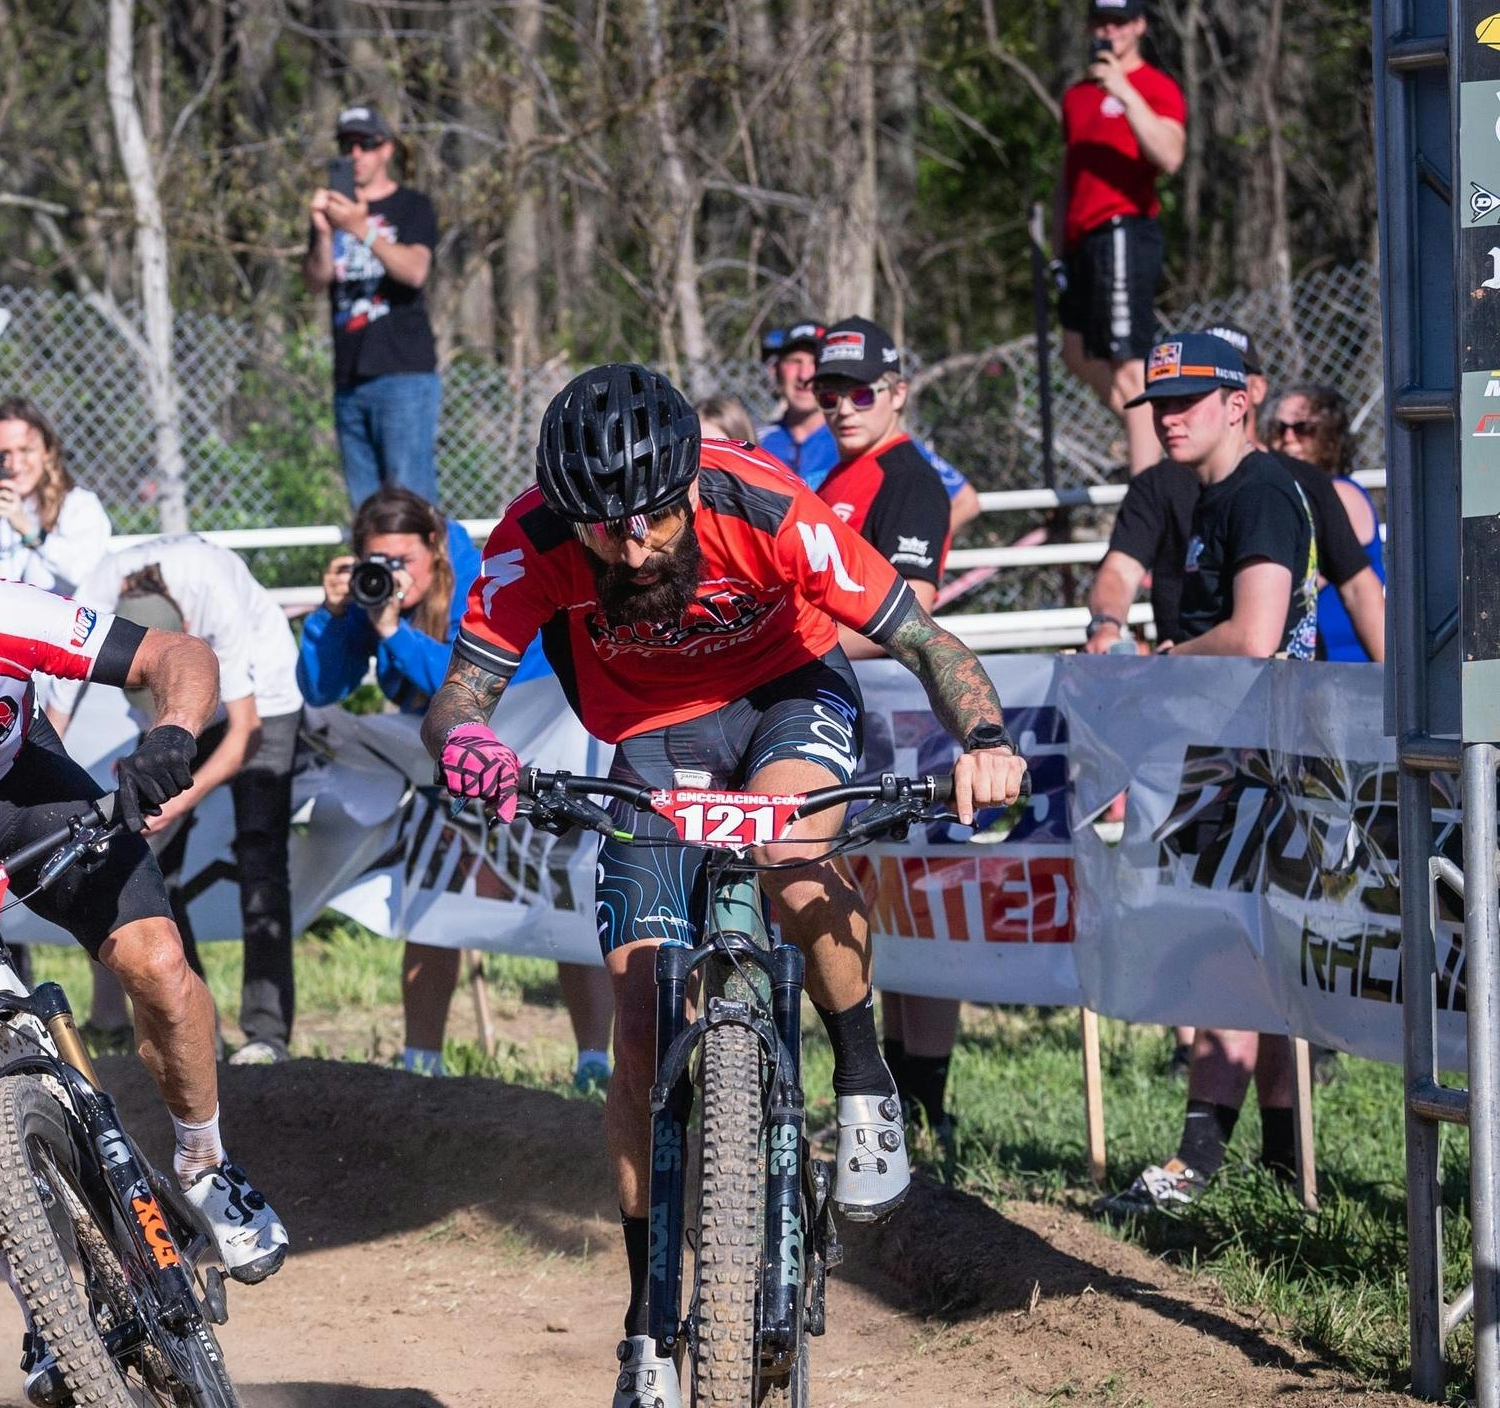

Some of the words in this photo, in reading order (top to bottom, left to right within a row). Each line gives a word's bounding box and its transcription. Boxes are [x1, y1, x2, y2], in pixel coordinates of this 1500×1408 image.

[71, 606, 97, 647] 100%
[674, 804, 775, 845] 121
[676, 792, 807, 805] GNCCRACING.COM
[770, 1124, 798, 1176] 36
[131, 1198, 181, 1270] FOX
[649, 1202, 669, 1282] FOX
[779, 1206, 804, 1287] FOX
